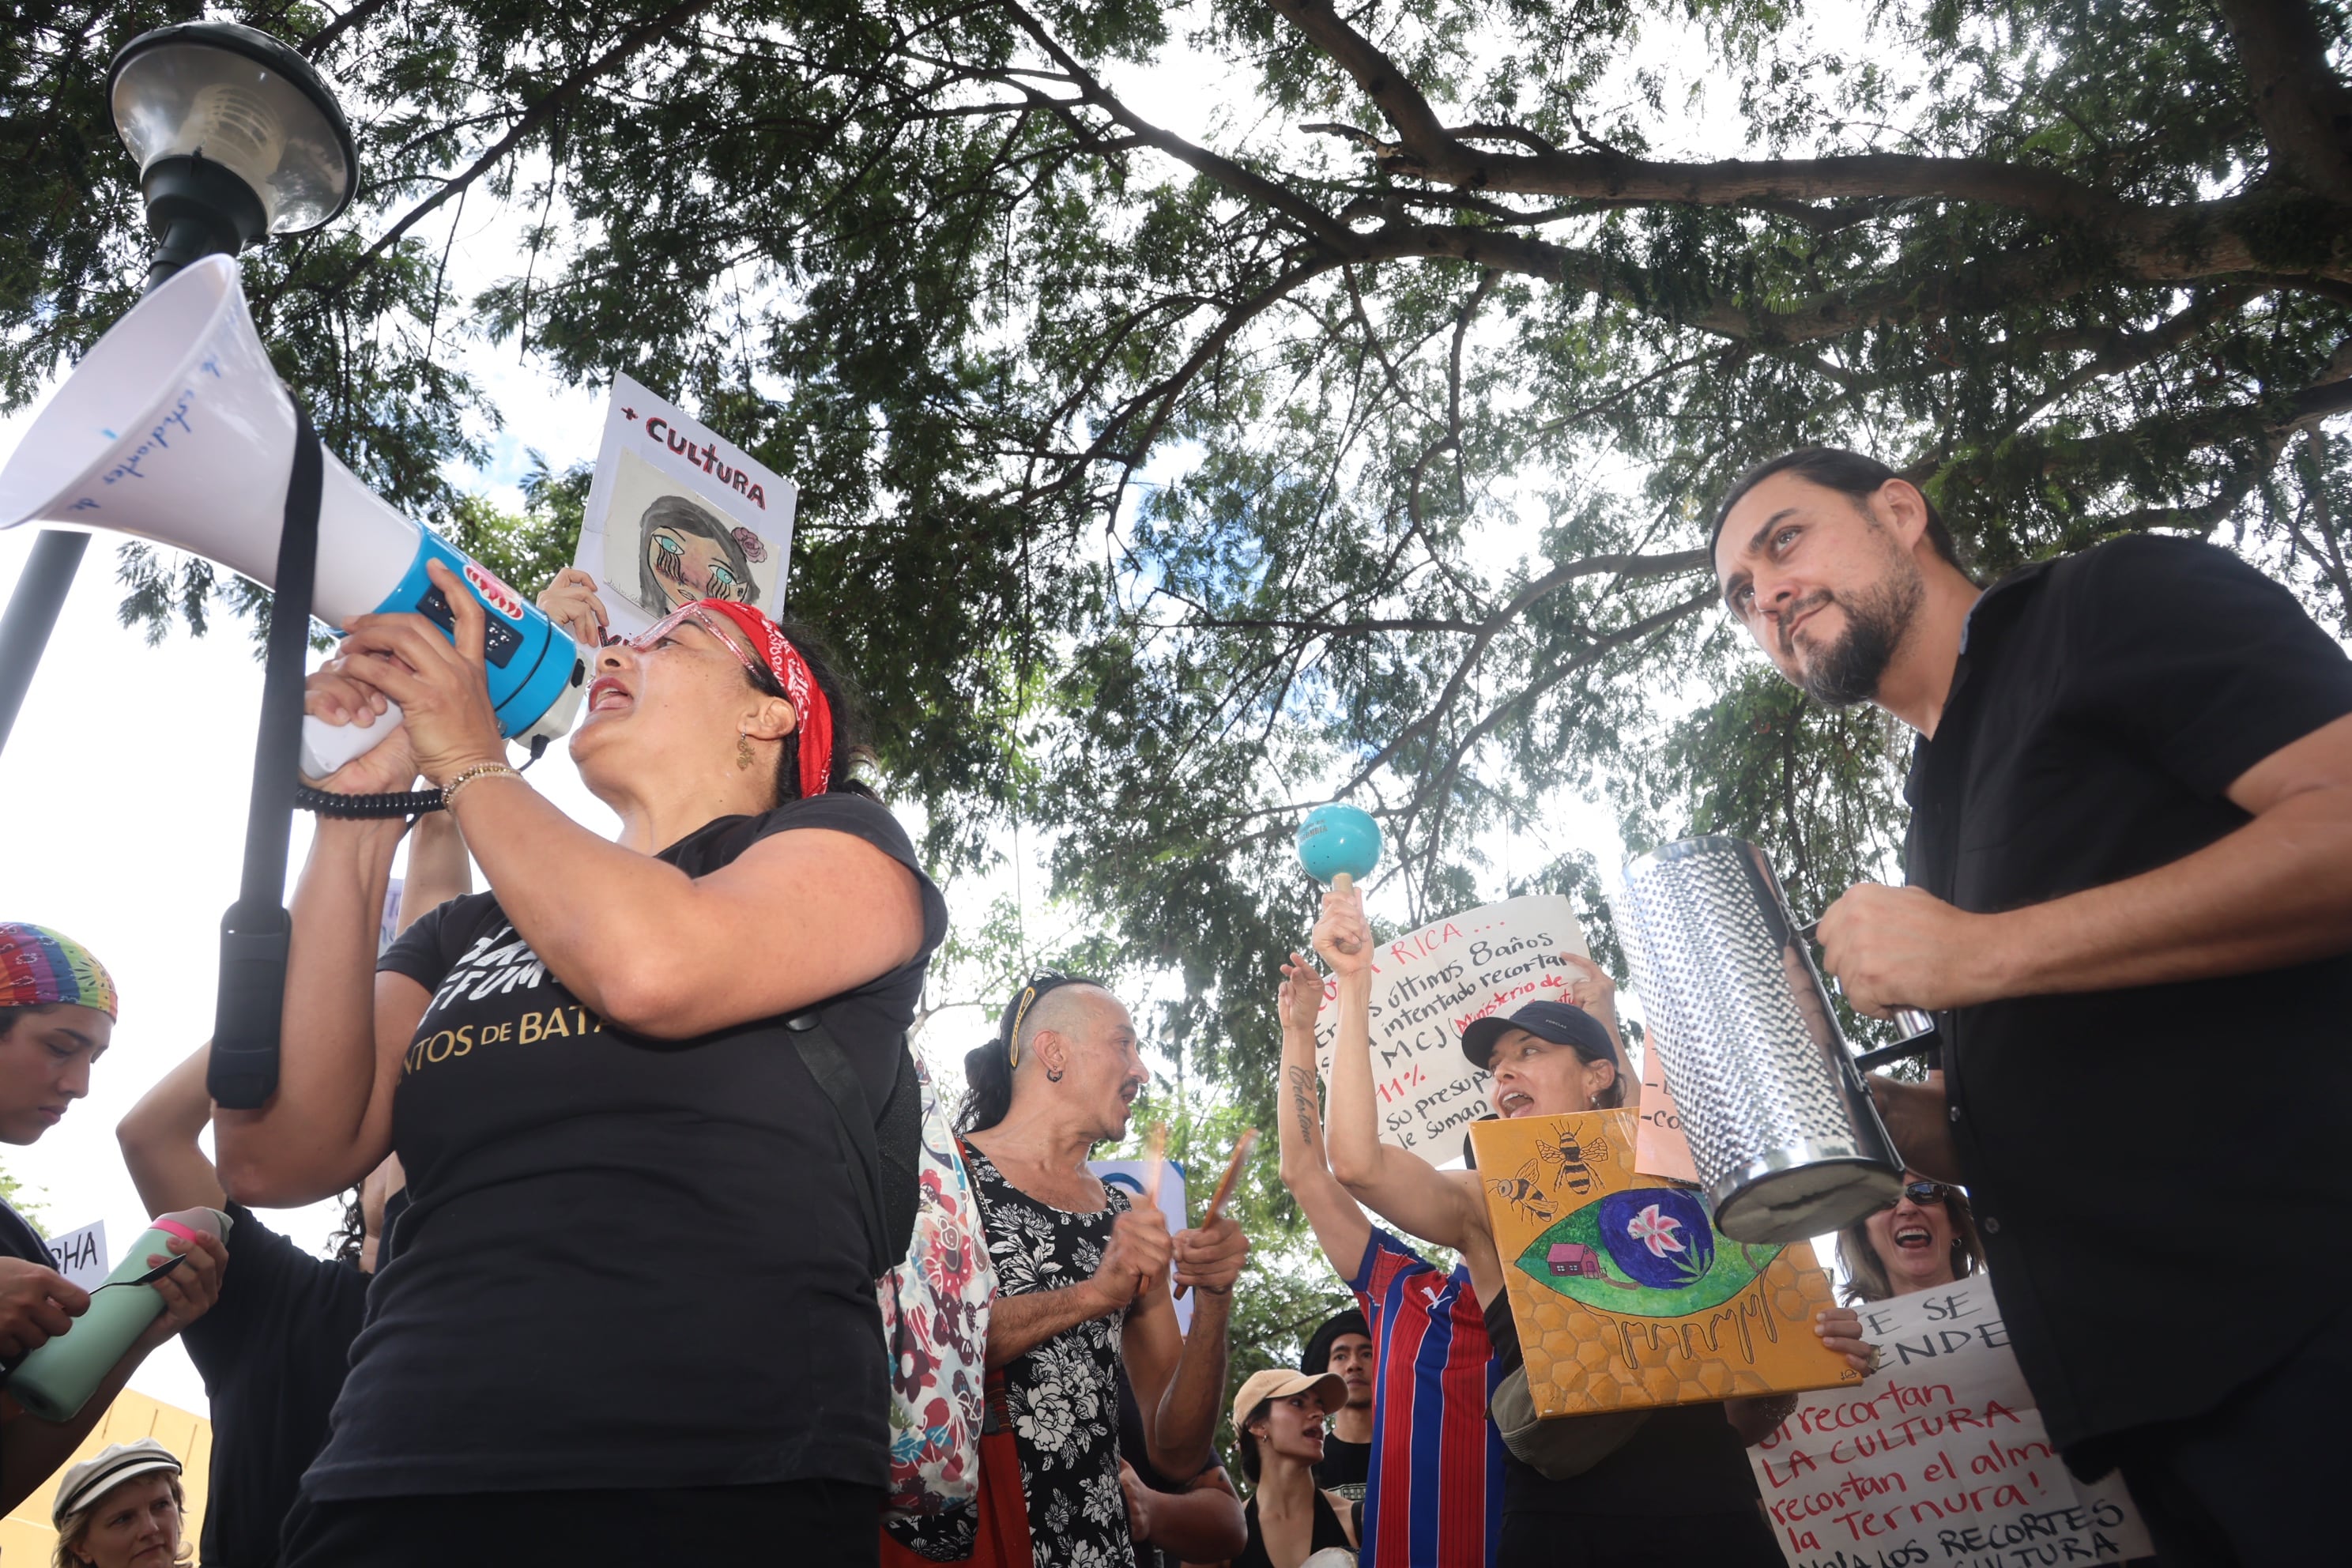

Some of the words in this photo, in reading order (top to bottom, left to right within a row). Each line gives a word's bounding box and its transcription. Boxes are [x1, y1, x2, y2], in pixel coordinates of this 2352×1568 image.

[1494, 933, 1554, 957] años
[1540, 973, 1569, 988] de
[1381, 982, 1476, 1038] intentado
[481, 1022, 512, 1046] DE
[1426, 1099, 1488, 1140] suman
[1922, 1291, 1982, 1321] SE
[1796, 1380, 1954, 1435] recortan
[1761, 1449, 1818, 1488] LA
[1830, 1400, 2022, 1464] CULTURA
[1770, 1471, 1908, 1526] recortan
[1924, 1450, 1958, 1483] el
[1787, 1526, 1822, 1554] la
[1937, 1498, 2124, 1557] RECORTES
